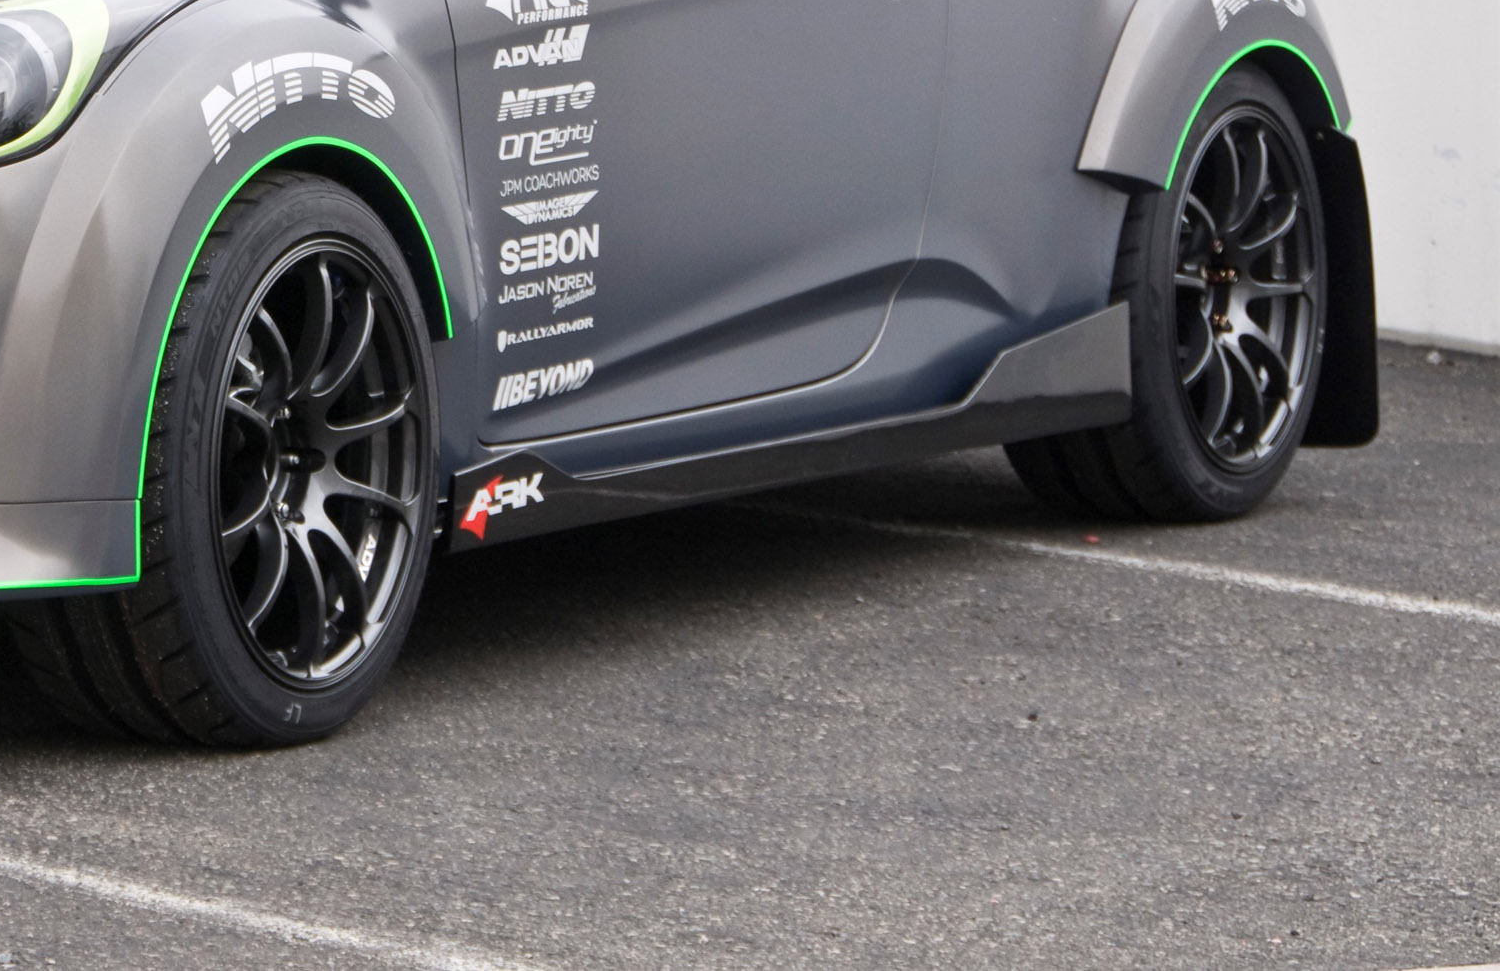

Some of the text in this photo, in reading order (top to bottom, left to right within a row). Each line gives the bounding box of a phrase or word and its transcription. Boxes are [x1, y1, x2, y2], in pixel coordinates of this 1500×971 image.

[517, 3, 589, 25] PERFORMANCE
[493, 23, 591, 70] ADVAN
[200, 52, 396, 165] NITTO
[497, 81, 596, 122] NITTO
[500, 164, 600, 198] JPM COACHWORKS
[500, 224, 600, 275] SEIBON
[499, 271, 595, 305] JASON NOREN
[507, 317, 595, 346] RALLYARMOR
